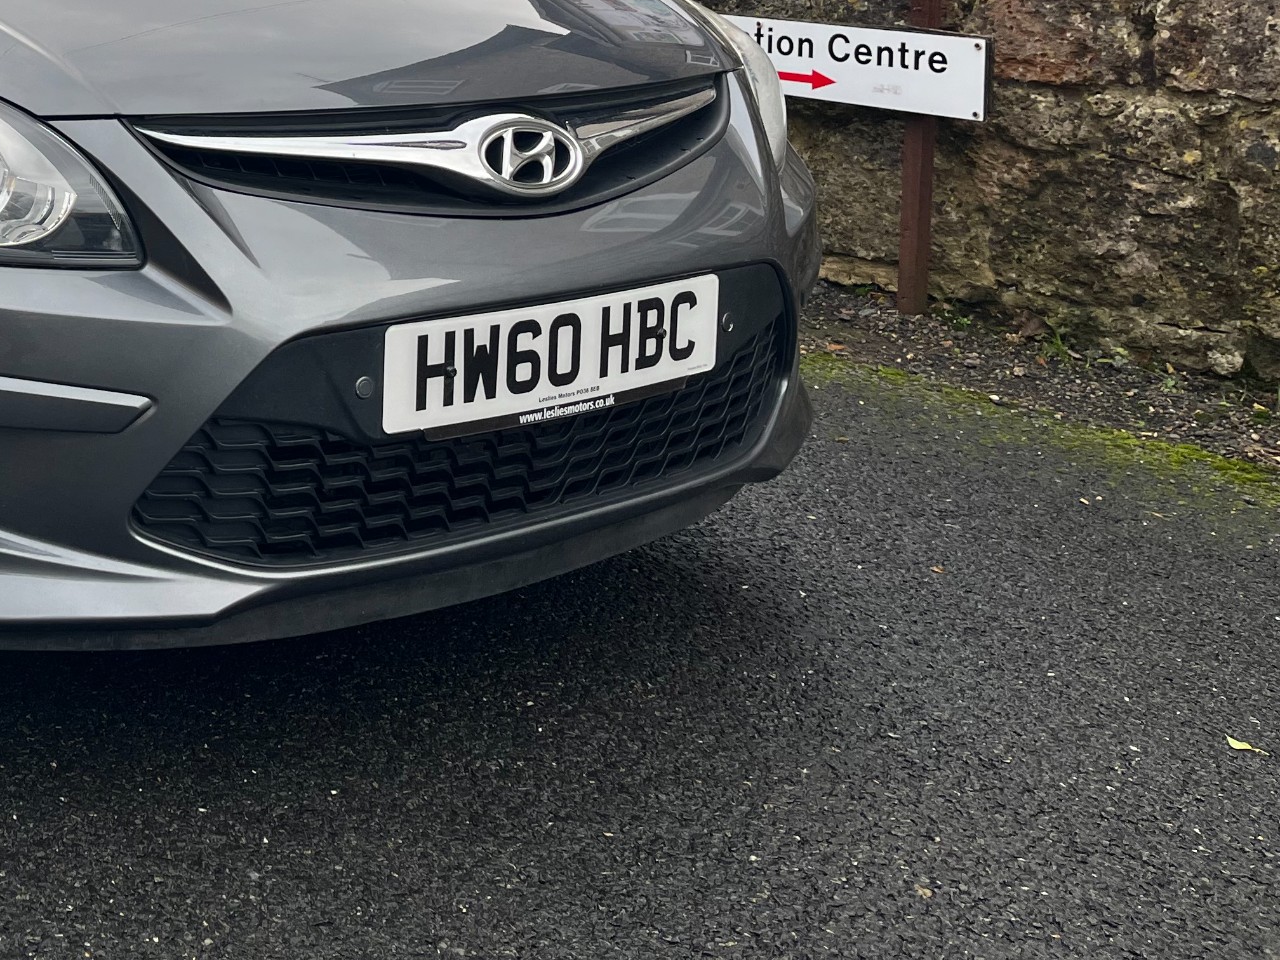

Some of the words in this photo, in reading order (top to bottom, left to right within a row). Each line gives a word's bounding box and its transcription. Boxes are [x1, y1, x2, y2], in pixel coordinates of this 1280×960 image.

[746, 26, 814, 59] tion
[828, 33, 948, 74] Centre
[416, 312, 582, 411] HW60
[599, 290, 698, 379] HBC
[519, 393, 616, 424] www.lesliesmotors.co.uk
[558, 391, 576, 399] Motors
